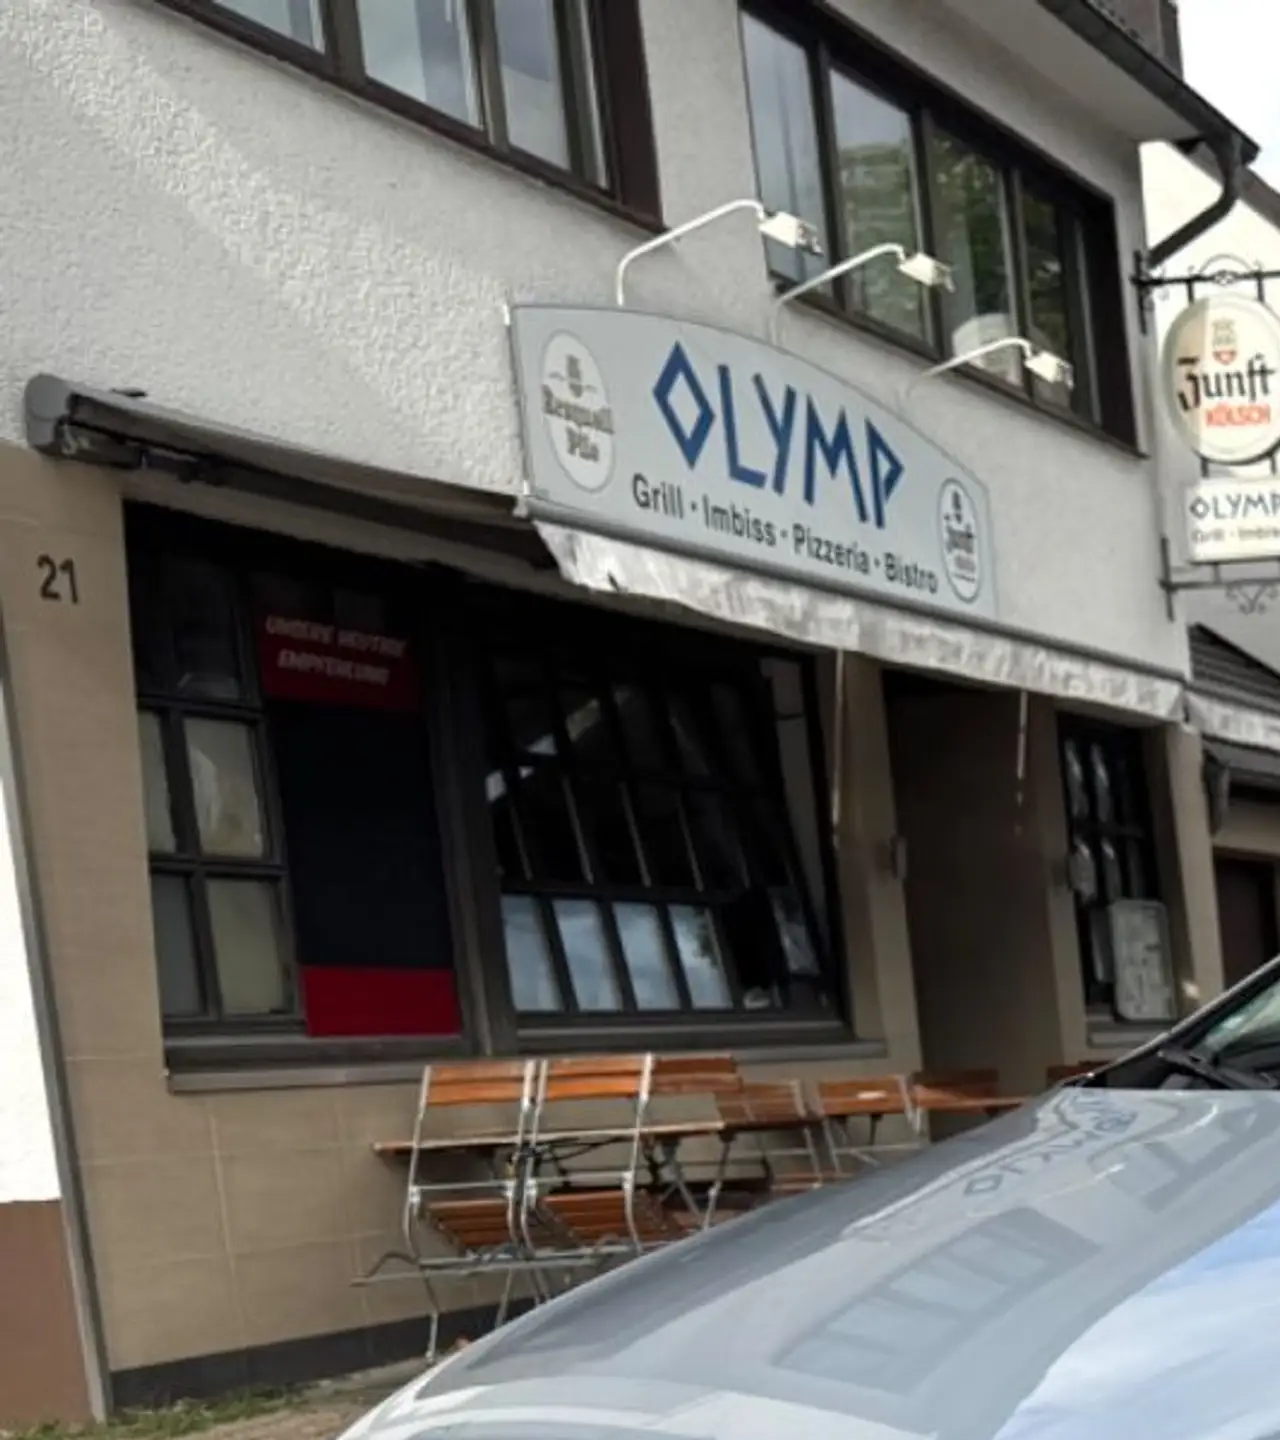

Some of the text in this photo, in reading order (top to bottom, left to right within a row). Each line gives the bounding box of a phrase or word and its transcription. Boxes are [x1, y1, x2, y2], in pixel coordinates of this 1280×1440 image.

[652, 339, 905, 530] OLYMP
[37, 554, 79, 604] 21
[632, 473, 684, 520] Grill
[702, 494, 776, 547] Imbiss
[792, 522, 870, 575] Pizzeria
[883, 551, 938, 595] Bistro
